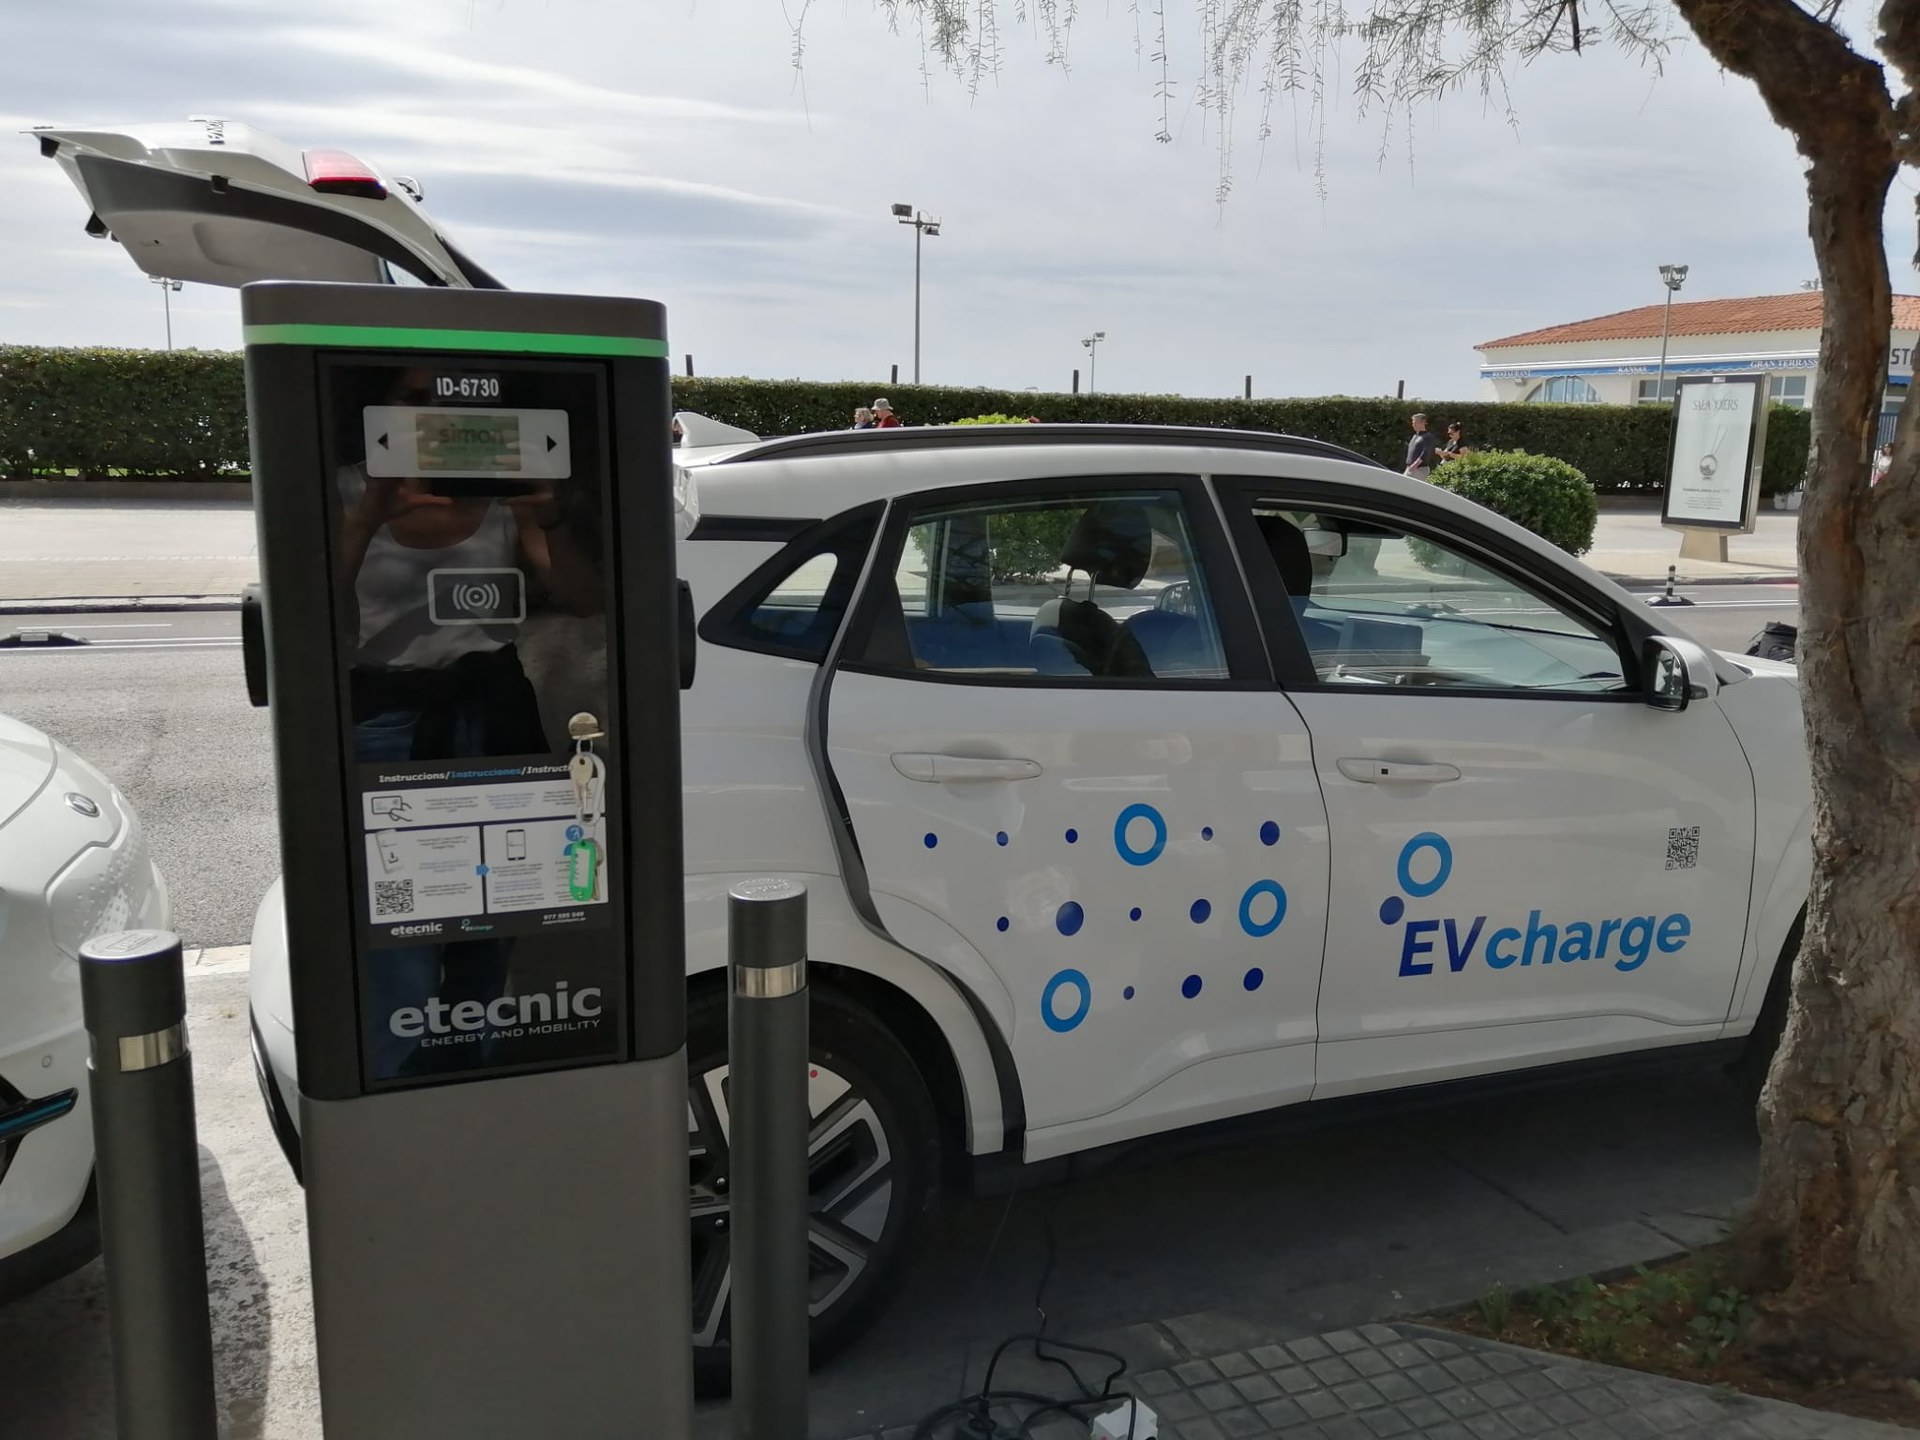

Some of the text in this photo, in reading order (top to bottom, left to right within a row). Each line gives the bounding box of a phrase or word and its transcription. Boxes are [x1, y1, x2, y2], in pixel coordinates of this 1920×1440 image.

[1750, 360, 1775, 370] GRAN
[436, 377, 500, 397] ID-6730
[390, 922, 443, 936] etecnic
[1398, 909, 1691, 977] EVcharge
[389, 980, 602, 1038] etecnic
[420, 1019, 601, 1048] ENERGY AND MOBILITY
